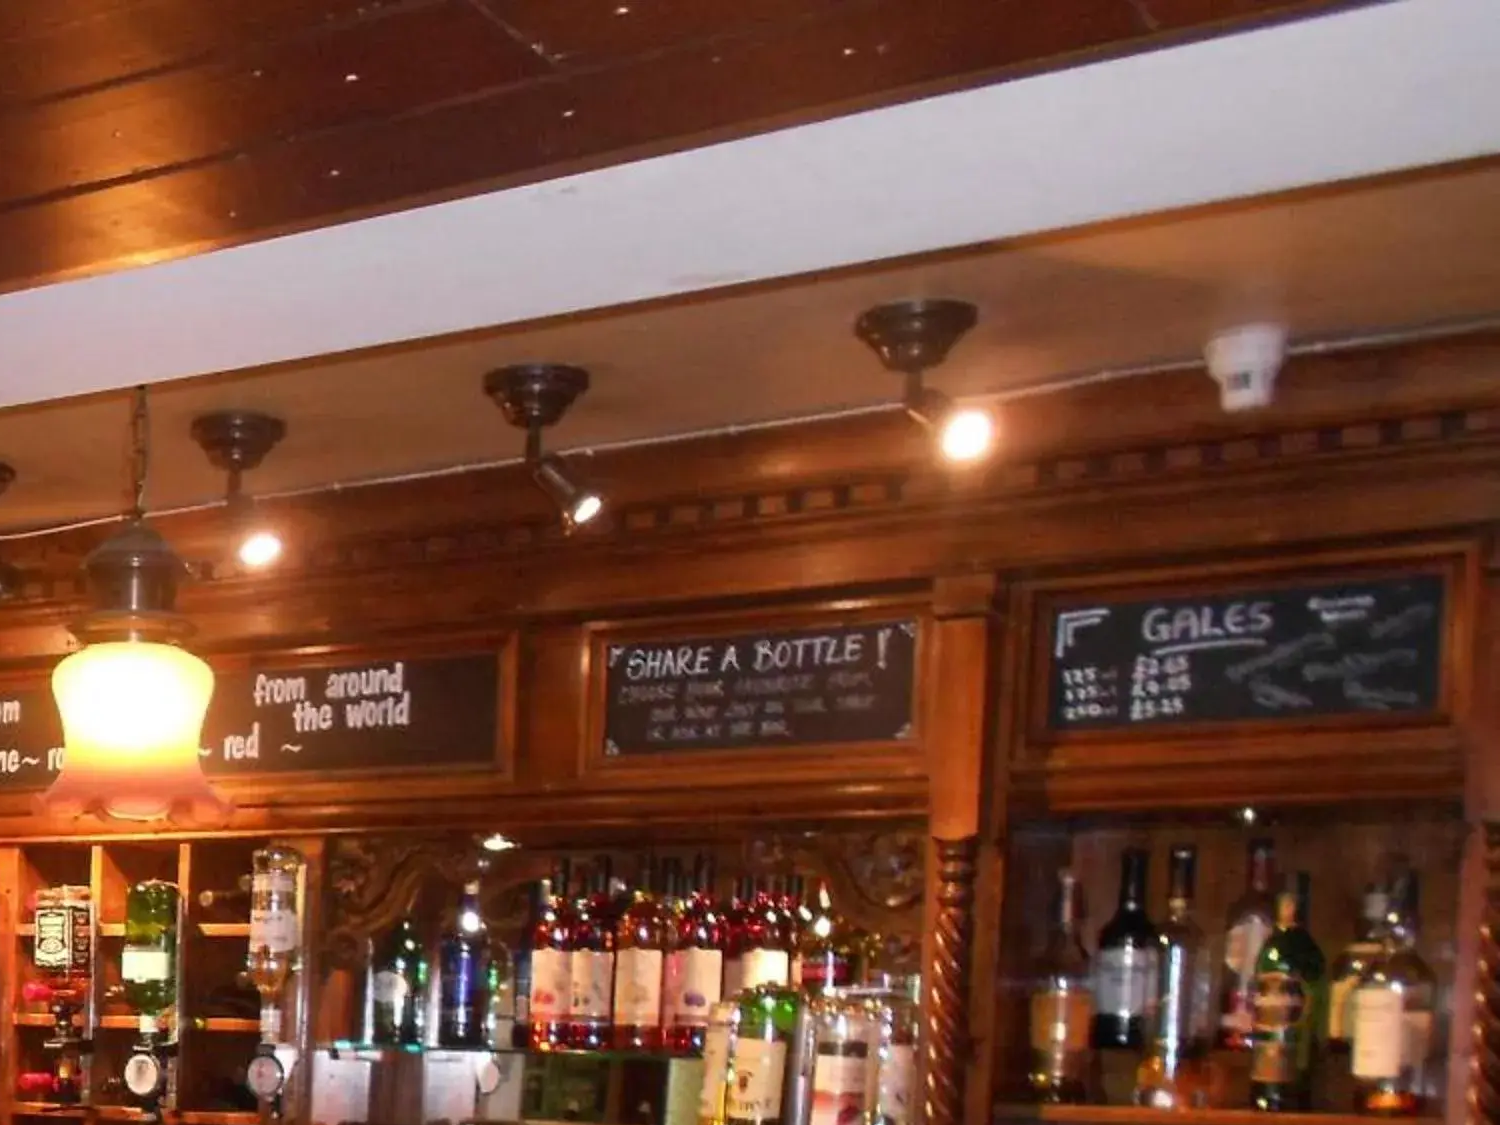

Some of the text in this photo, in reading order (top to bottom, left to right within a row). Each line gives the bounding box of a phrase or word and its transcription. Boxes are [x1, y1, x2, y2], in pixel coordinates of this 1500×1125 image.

[1140, 601, 1275, 642] GALES
[625, 645, 713, 681] SHARE
[719, 644, 741, 673] A
[752, 634, 865, 673] BOTTLE
[253, 661, 404, 707] from around
[292, 689, 411, 733] the world
[223, 721, 261, 761] red
